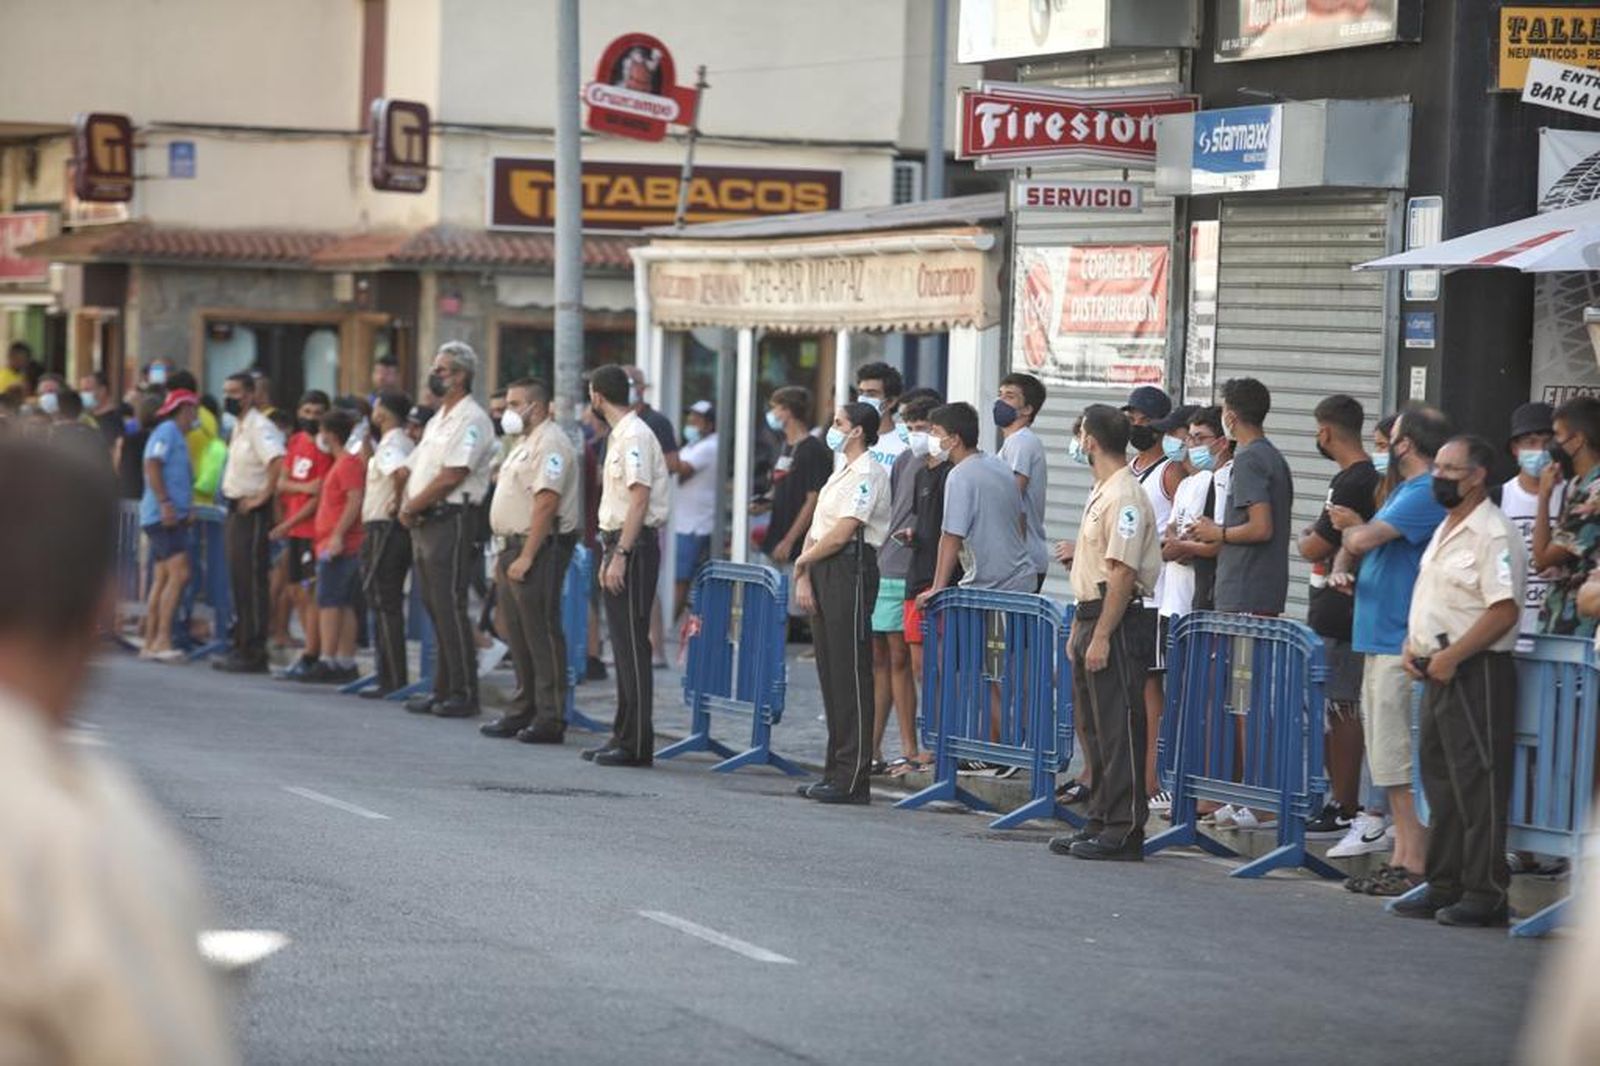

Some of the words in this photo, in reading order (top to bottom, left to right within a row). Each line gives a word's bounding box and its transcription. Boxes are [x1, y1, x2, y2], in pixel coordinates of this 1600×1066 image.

[1530, 82, 1566, 104] BAR
[1568, 91, 1591, 108] LA
[580, 174, 828, 213] TABACOS
[1026, 187, 1132, 207] SERVICIO
[1135, 250, 1153, 278] DE
